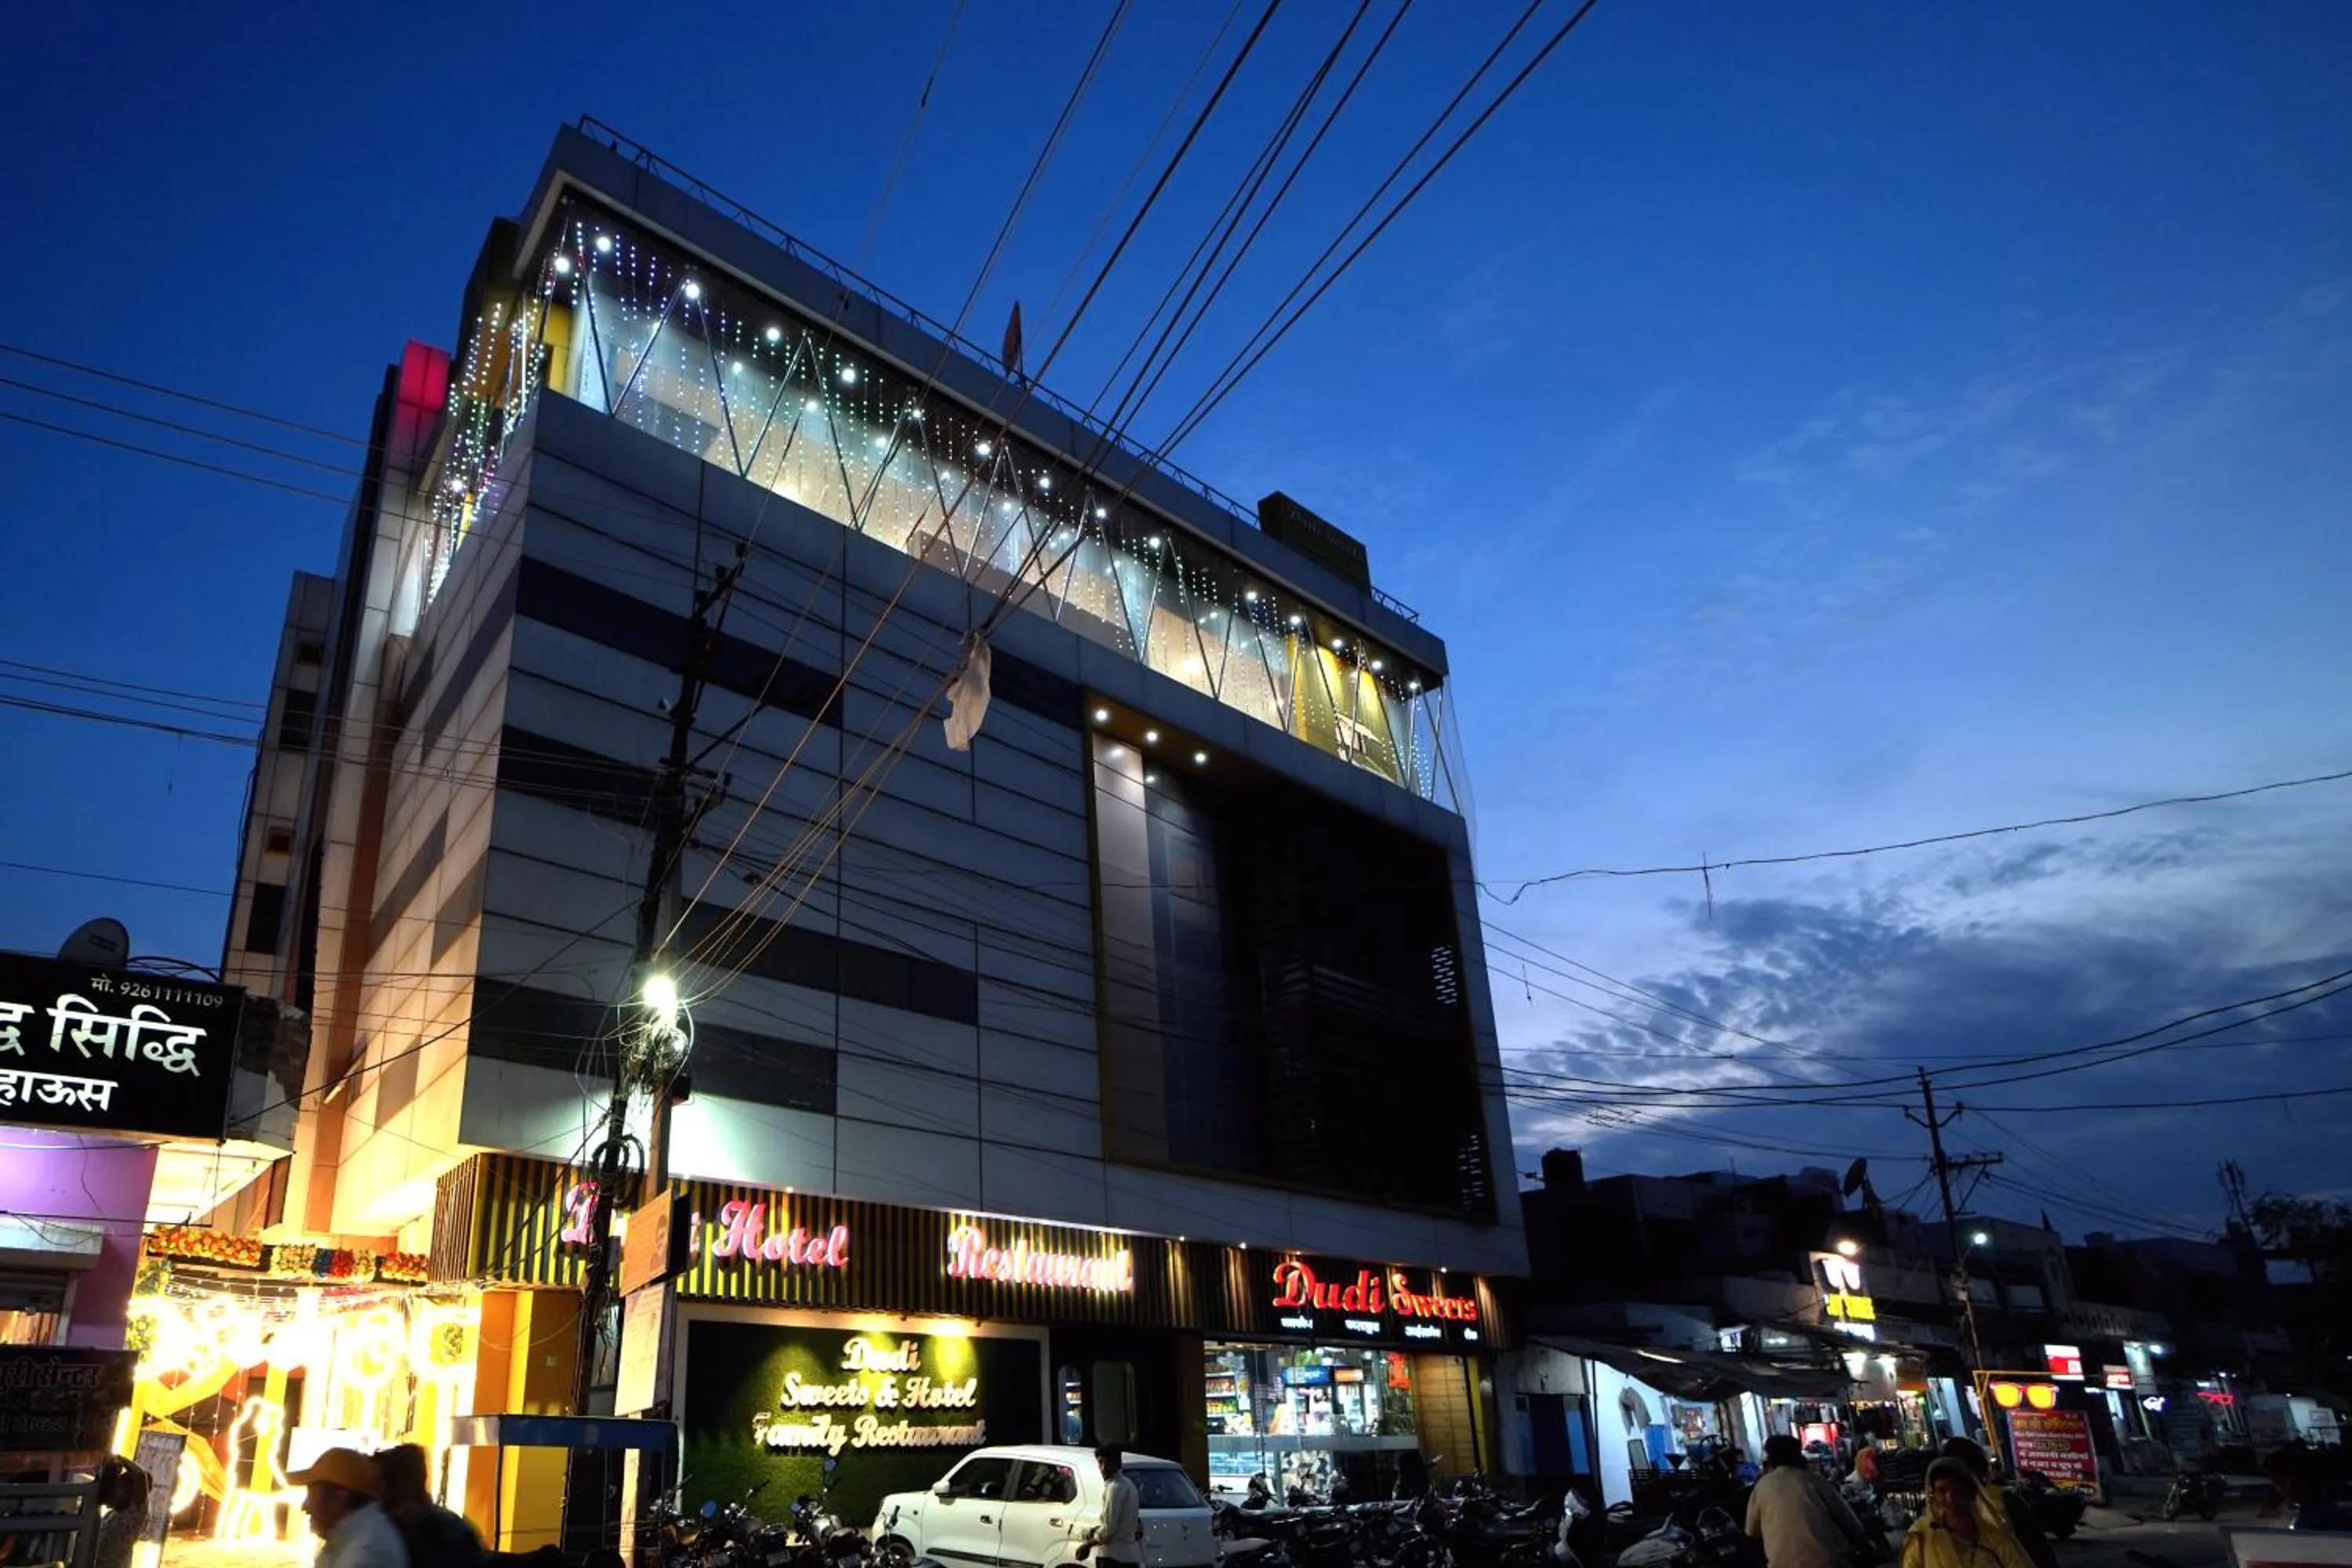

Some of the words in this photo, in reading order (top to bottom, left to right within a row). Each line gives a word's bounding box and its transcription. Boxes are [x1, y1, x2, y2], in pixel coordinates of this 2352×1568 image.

[90, 973, 114, 993] मो.
[119, 981, 224, 1009] 9261111109
[45, 993, 208, 1077] सिद्धि
[711, 1199, 850, 1267] Hotel
[946, 1225, 1135, 1292] Restaurant
[1272, 1261, 1386, 1314] Dudi
[1391, 1272, 1479, 1321] Sweets
[840, 1336, 922, 1372] Dudi
[781, 1371, 869, 1407] Sweets
[874, 1376, 900, 1408] &
[901, 1377, 978, 1408] Hotel
[752, 1411, 848, 1457] Family
[851, 1414, 987, 1448] Restaurant
